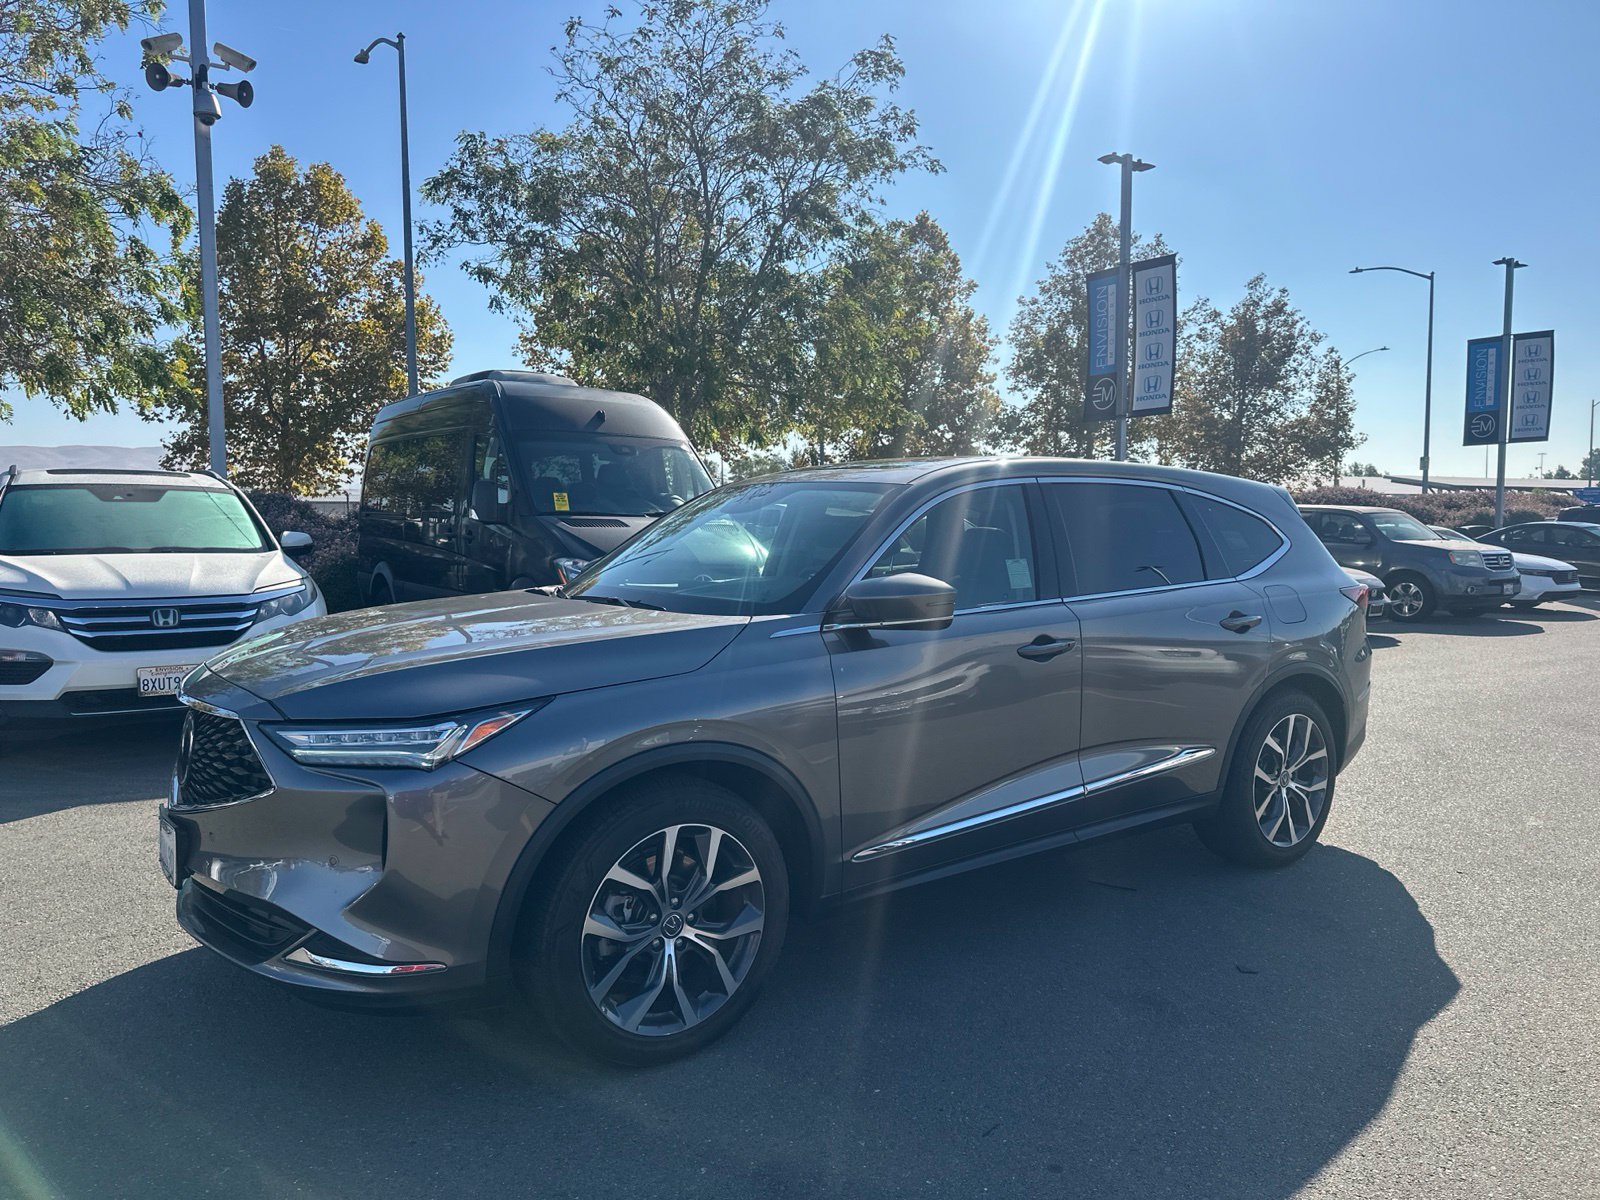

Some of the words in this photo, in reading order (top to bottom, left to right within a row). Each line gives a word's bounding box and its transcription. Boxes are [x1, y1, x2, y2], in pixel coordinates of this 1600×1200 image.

[1139, 294, 1170, 305] HONDA
[1096, 285, 1107, 368] ENVISION
[1138, 327, 1170, 338] HONDA
[1138, 360, 1170, 370] HONDA
[1474, 348, 1487, 408] ENVISION
[1136, 393, 1168, 402] HONDA
